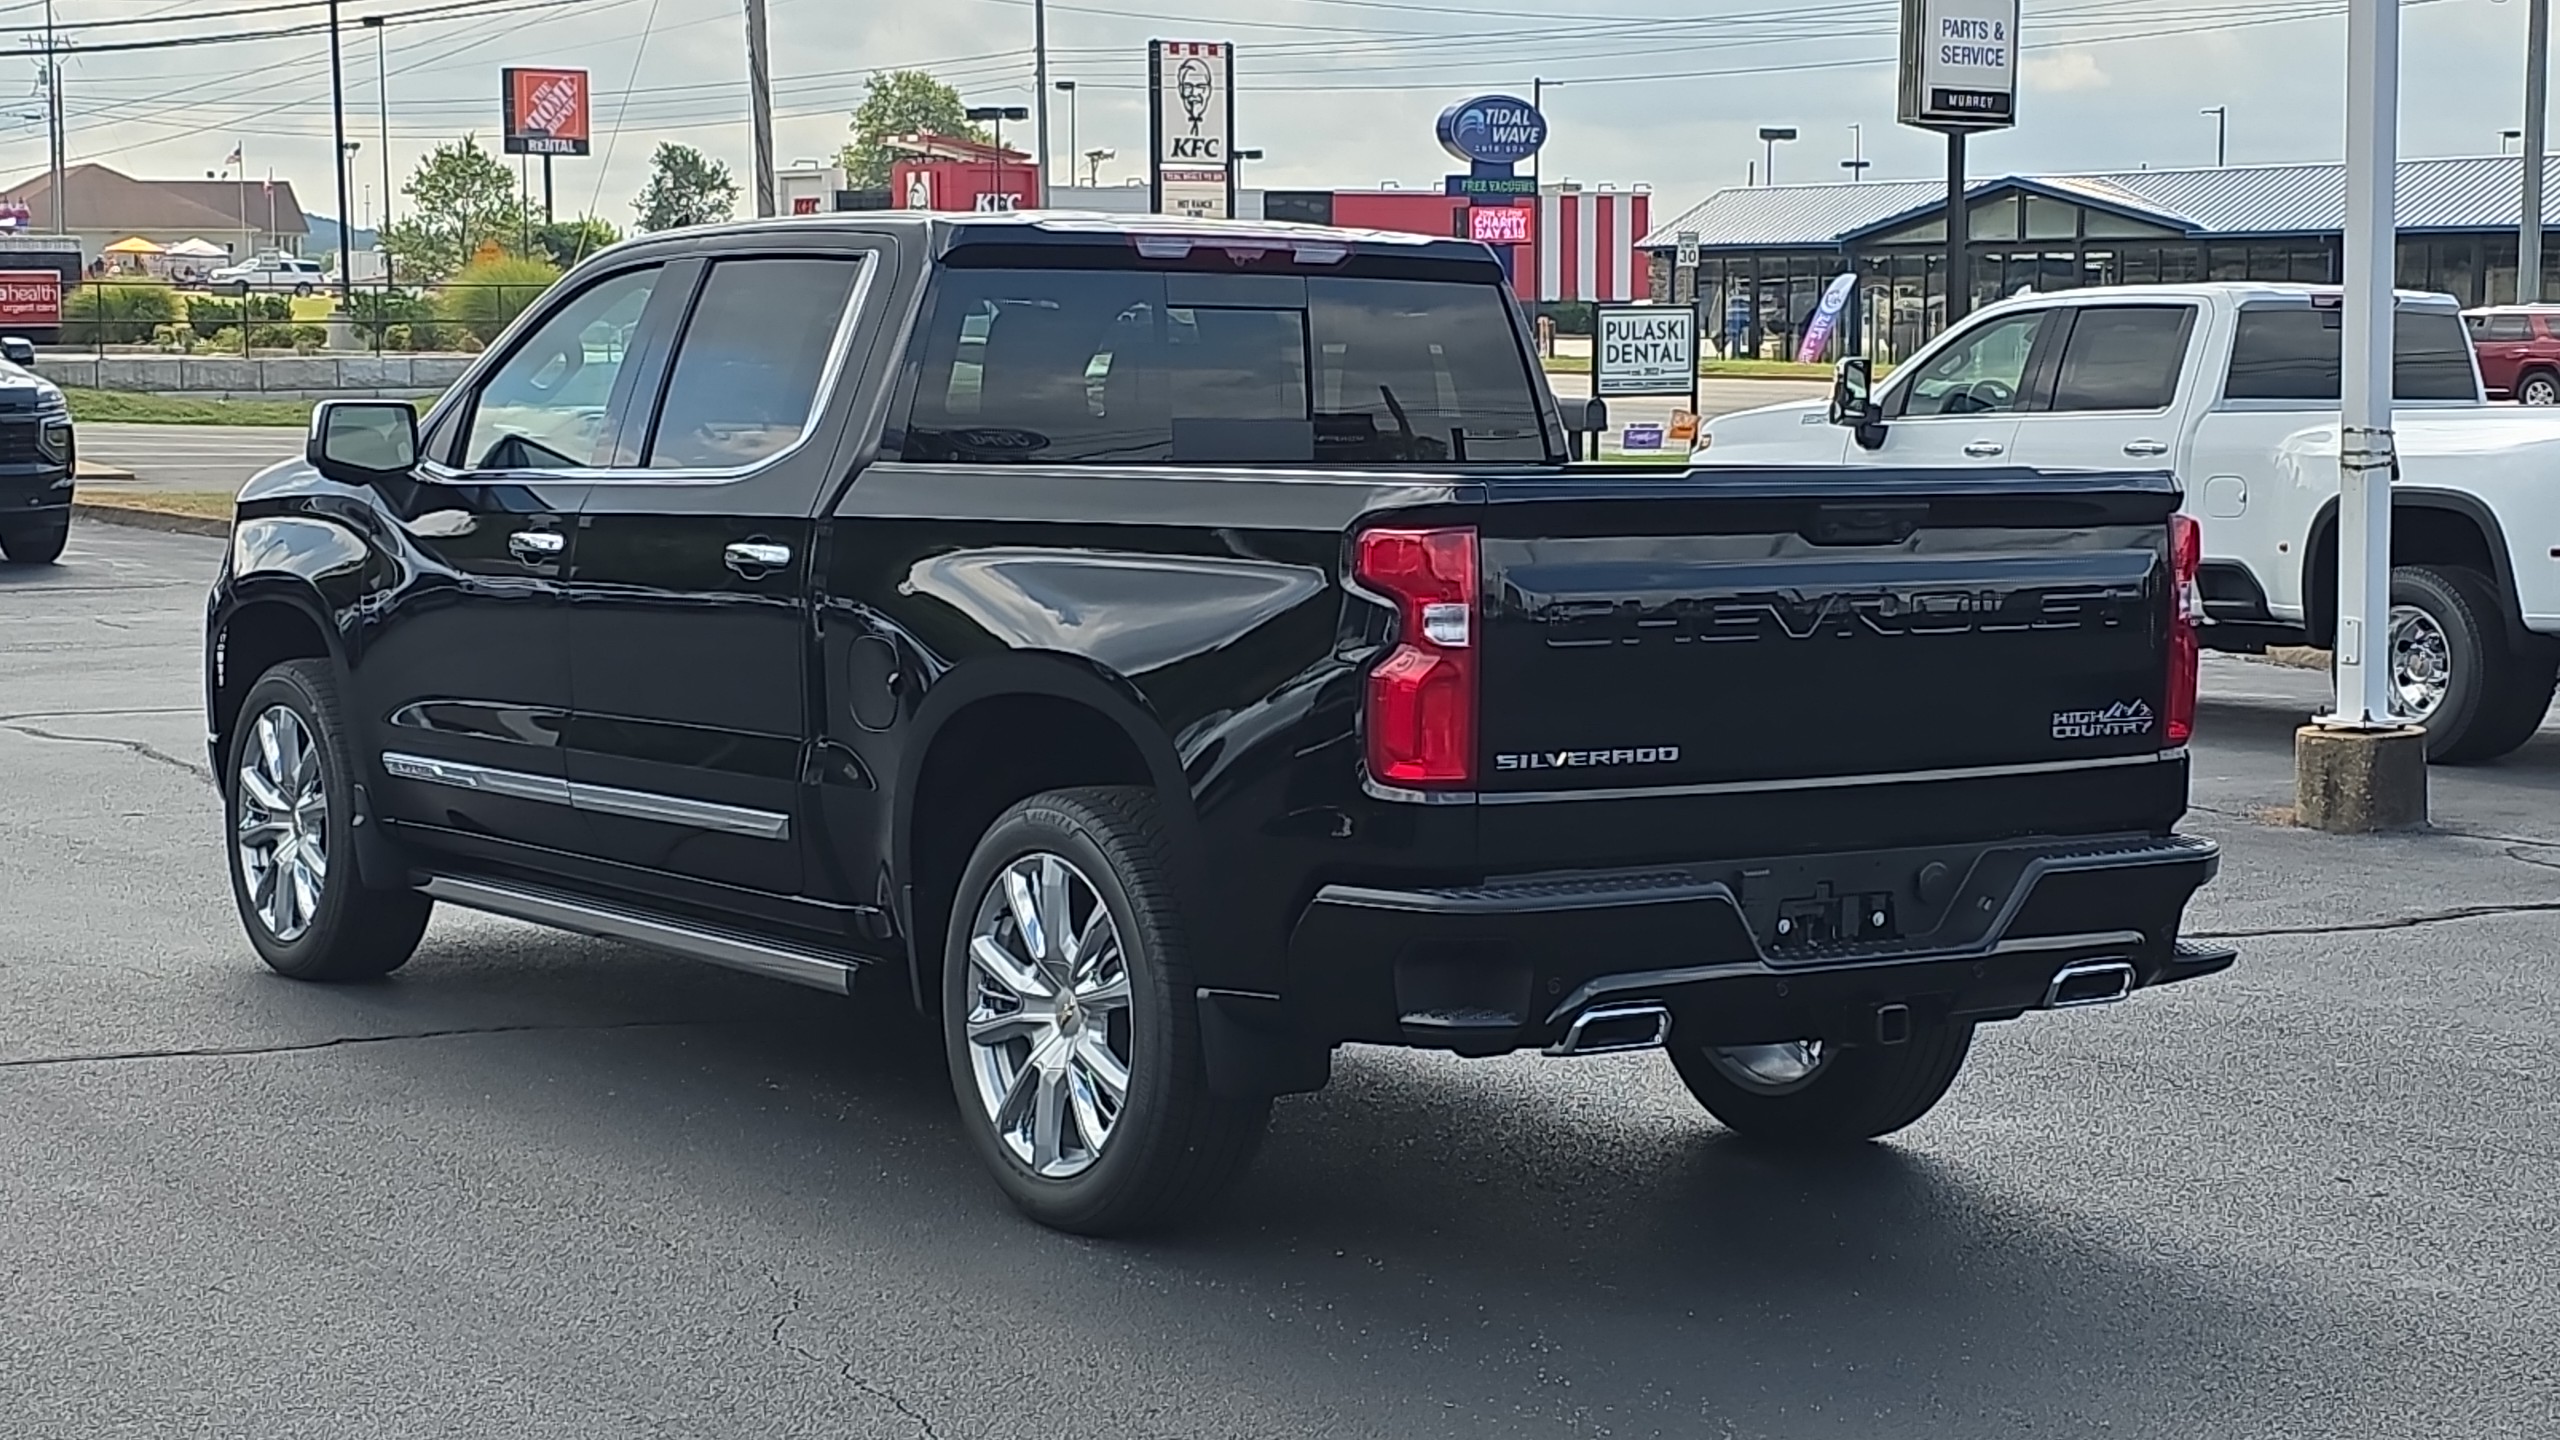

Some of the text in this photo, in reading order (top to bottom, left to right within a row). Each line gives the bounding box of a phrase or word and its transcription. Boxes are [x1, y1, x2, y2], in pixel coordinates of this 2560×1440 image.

[1941, 18, 2005, 41] PARTS &
[1940, 45, 2005, 67] SERVICE
[525, 76, 578, 129] HOME
[1948, 94, 1994, 108] MURREY
[1485, 108, 1531, 125] TIDAL
[1492, 126, 1540, 144] WAVE
[527, 139, 577, 153] RENTAL
[1171, 137, 1220, 158] KFC
[1461, 180, 1487, 192] FREE
[975, 193, 1023, 213] KFC
[1474, 215, 1527, 229] CHARITY
[1475, 228, 1501, 240] DAY
[1679, 249, 1697, 263] 30
[1606, 319, 1685, 341] PULASKI
[1606, 342, 1686, 364] DENTAL
[1546, 588, 2138, 647] CHEVROLET
[2052, 710, 2105, 725] HIGH
[2052, 720, 2152, 738] COUNTRY
[1495, 746, 1680, 770] SILVERADO
